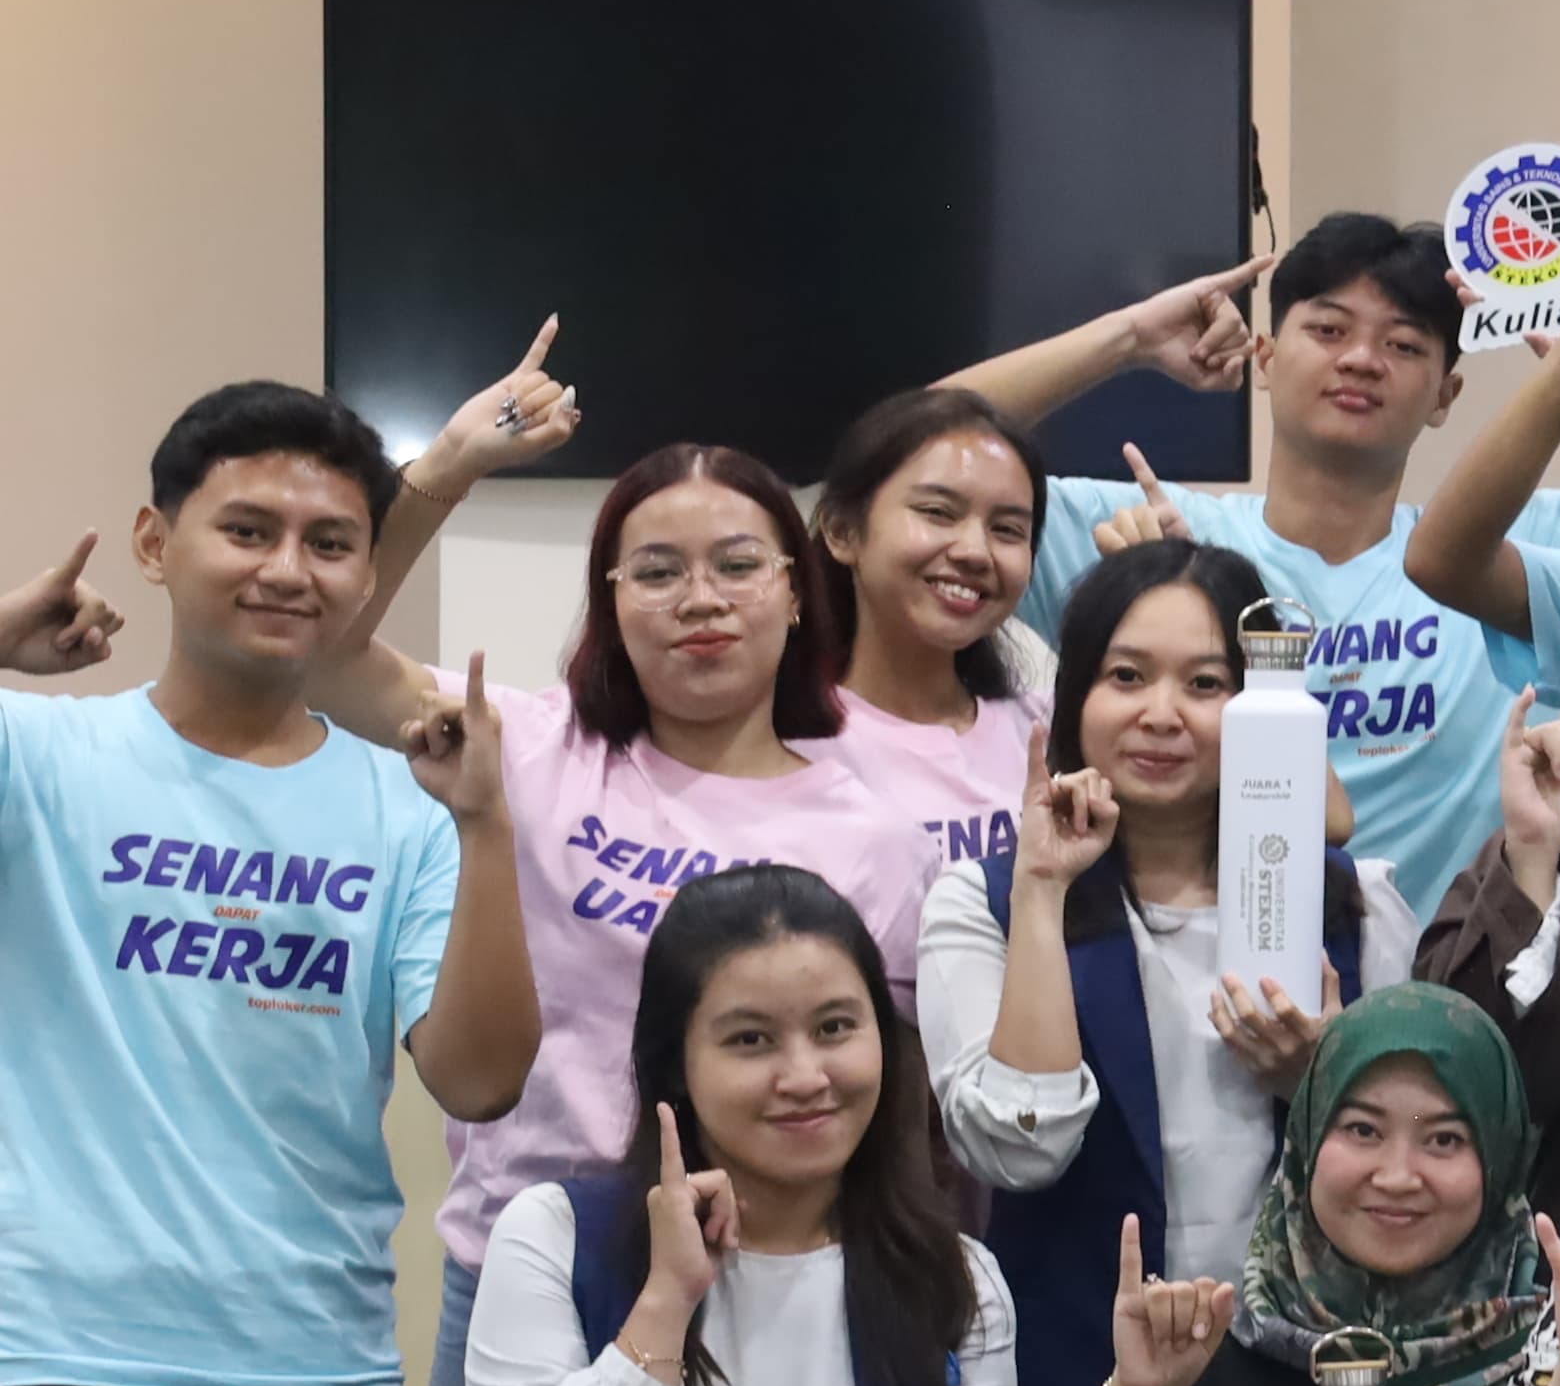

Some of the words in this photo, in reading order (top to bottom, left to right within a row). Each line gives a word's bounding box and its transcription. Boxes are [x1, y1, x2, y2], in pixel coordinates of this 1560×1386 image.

[1288, 616, 1440, 666] NANG
[1309, 682, 1436, 739] RJA
[102, 833, 376, 913] SENANG
[566, 814, 772, 889] SENA
[213, 905, 260, 922] DAPAT
[572, 877, 667, 934] UA
[1258, 869, 1272, 952] STEKOM
[115, 914, 351, 995] KERJA
[247, 996, 342, 1017] toploker.com
